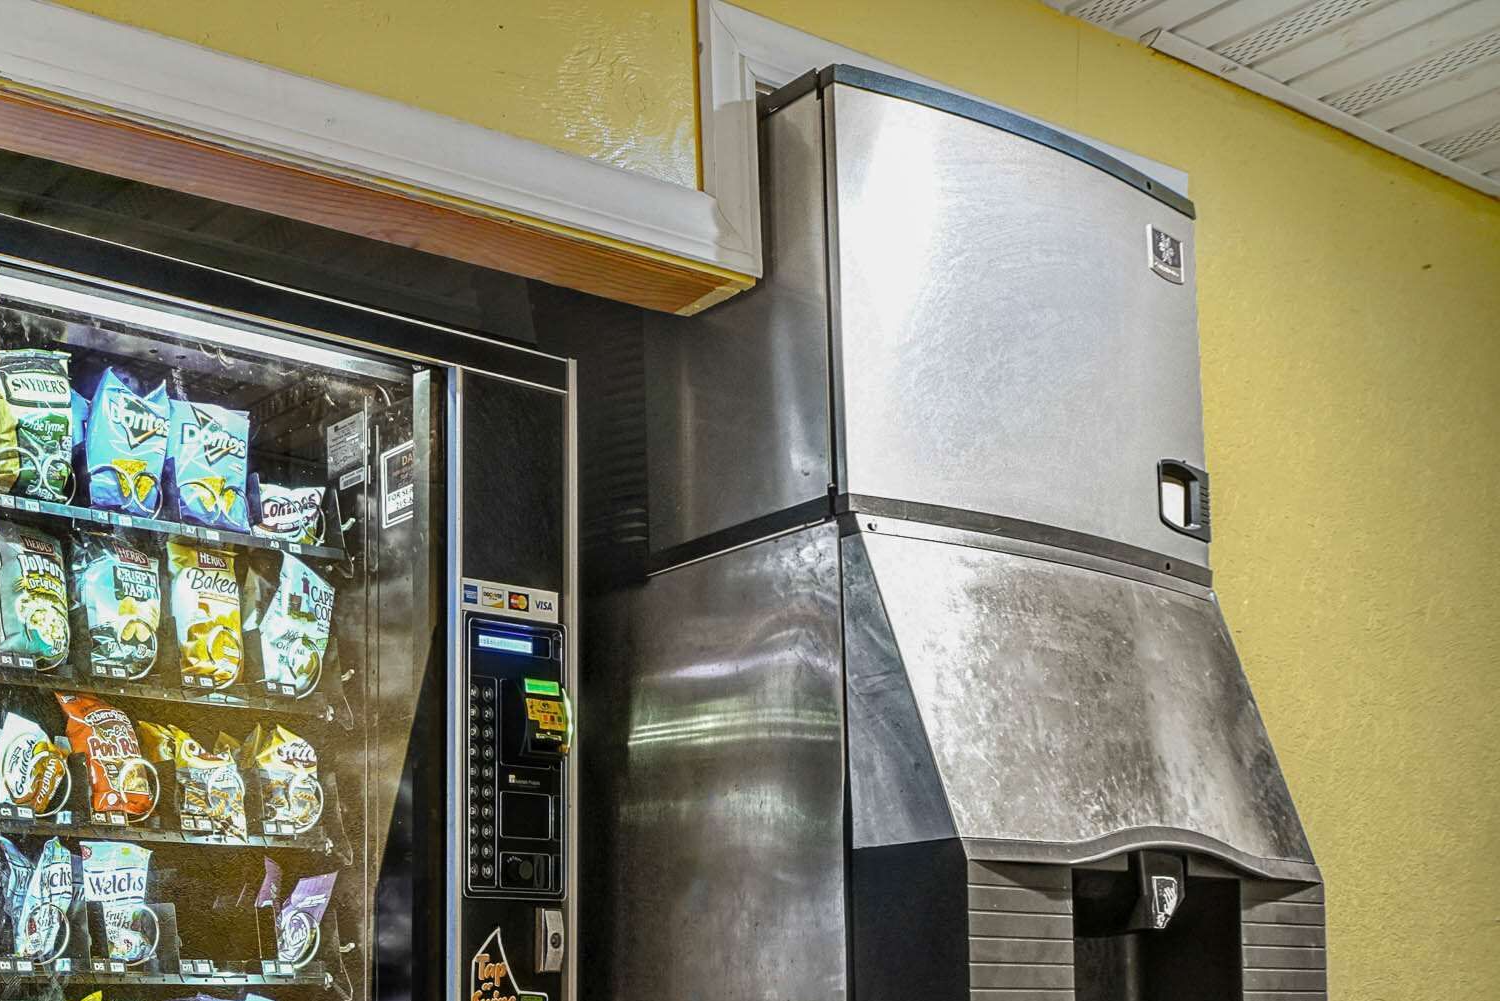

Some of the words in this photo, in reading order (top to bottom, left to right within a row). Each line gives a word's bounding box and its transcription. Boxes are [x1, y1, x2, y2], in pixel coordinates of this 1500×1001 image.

[12, 378, 67, 394] SNYDER'S
[182, 420, 246, 459] Doritos
[535, 600, 553, 611] VISA
[476, 953, 507, 987] Tap
[481, 982, 493, 991] or
